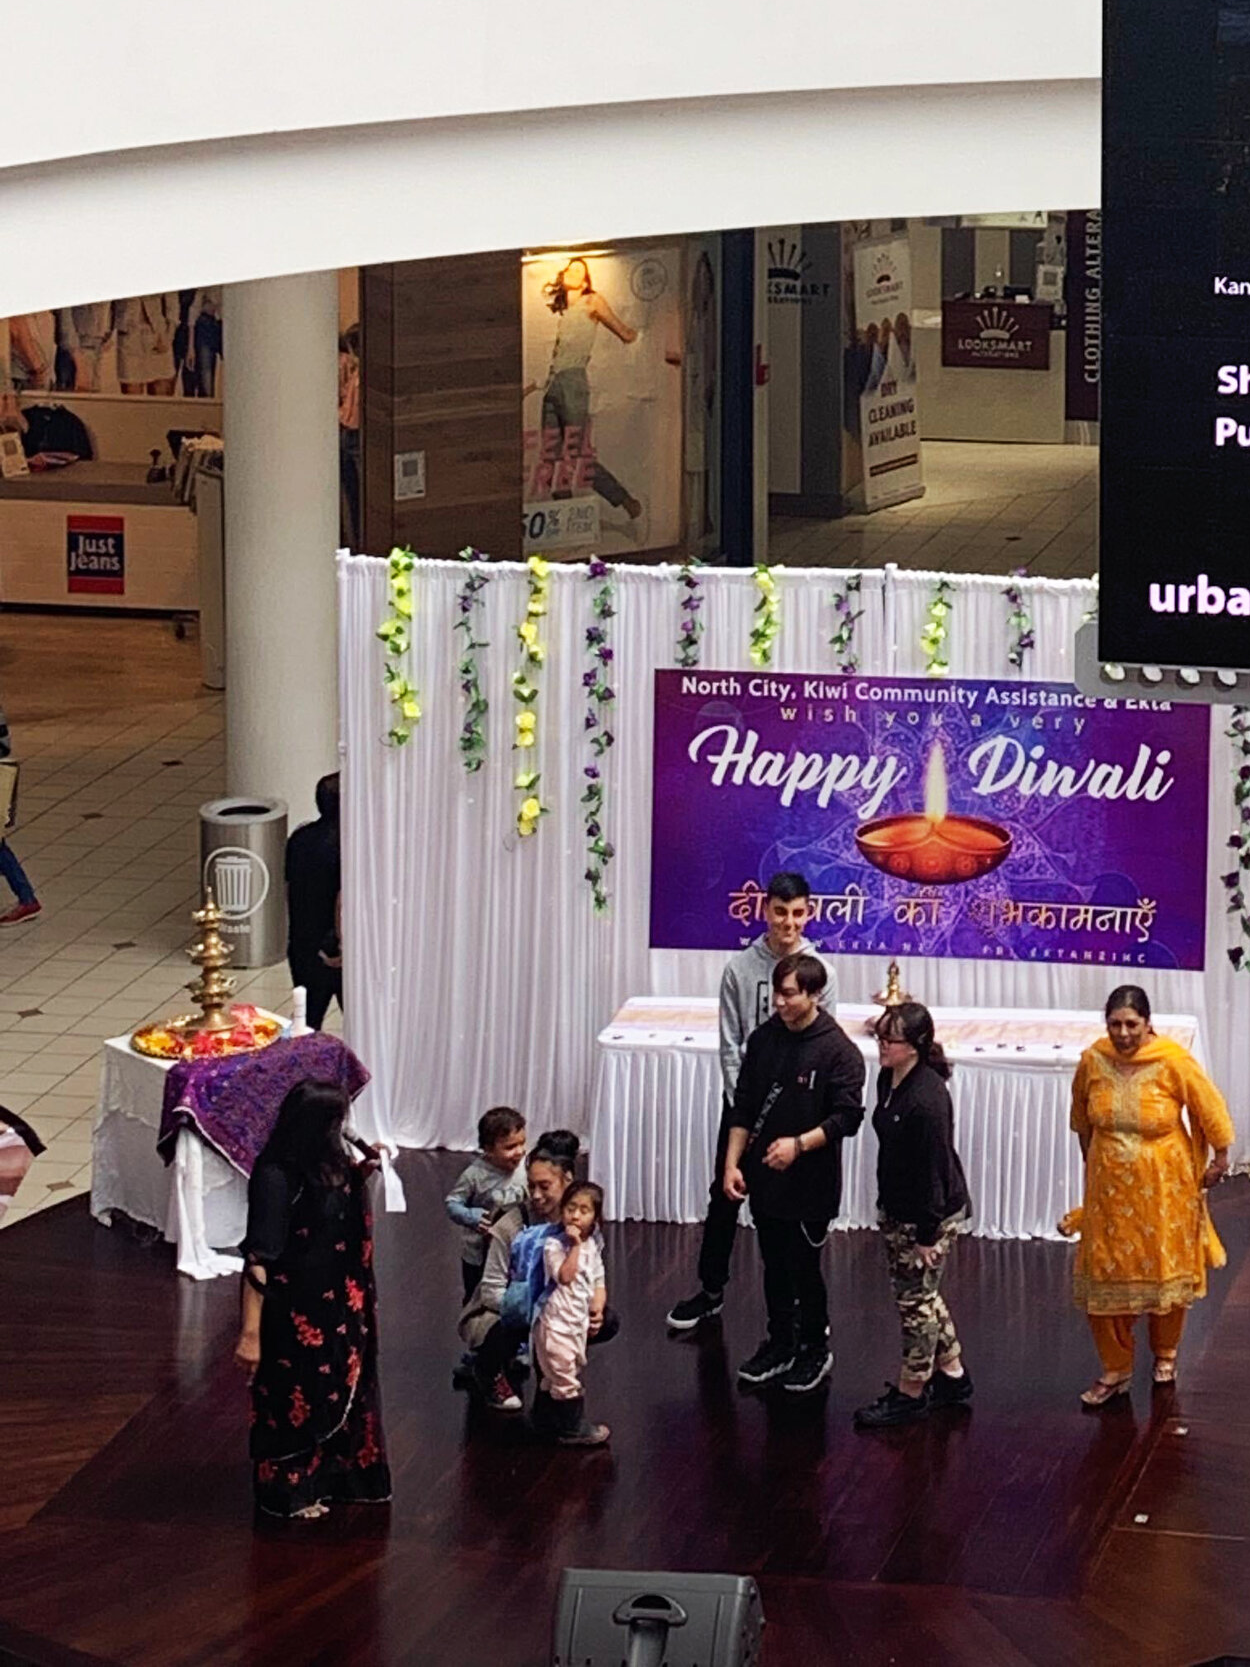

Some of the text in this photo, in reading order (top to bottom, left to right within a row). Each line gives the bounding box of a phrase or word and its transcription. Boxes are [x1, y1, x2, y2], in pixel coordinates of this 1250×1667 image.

[957, 338, 1033, 352] LOOKSMART
[1084, 287, 1101, 383] CLOTHING
[881, 381, 898, 397] DRY
[868, 398, 915, 424] CLEANING
[868, 420, 917, 448] AVAILABLE
[78, 535, 116, 554] Just
[69, 551, 120, 571] Jeans
[681, 677, 741, 695] North
[749, 679, 797, 702] City,
[803, 681, 848, 700] Kiwi
[855, 683, 978, 710] Community
[985, 688, 1097, 709] Assistance
[780, 704, 1086, 734] wish you a very
[688, 725, 1175, 820] Happy Diwali
